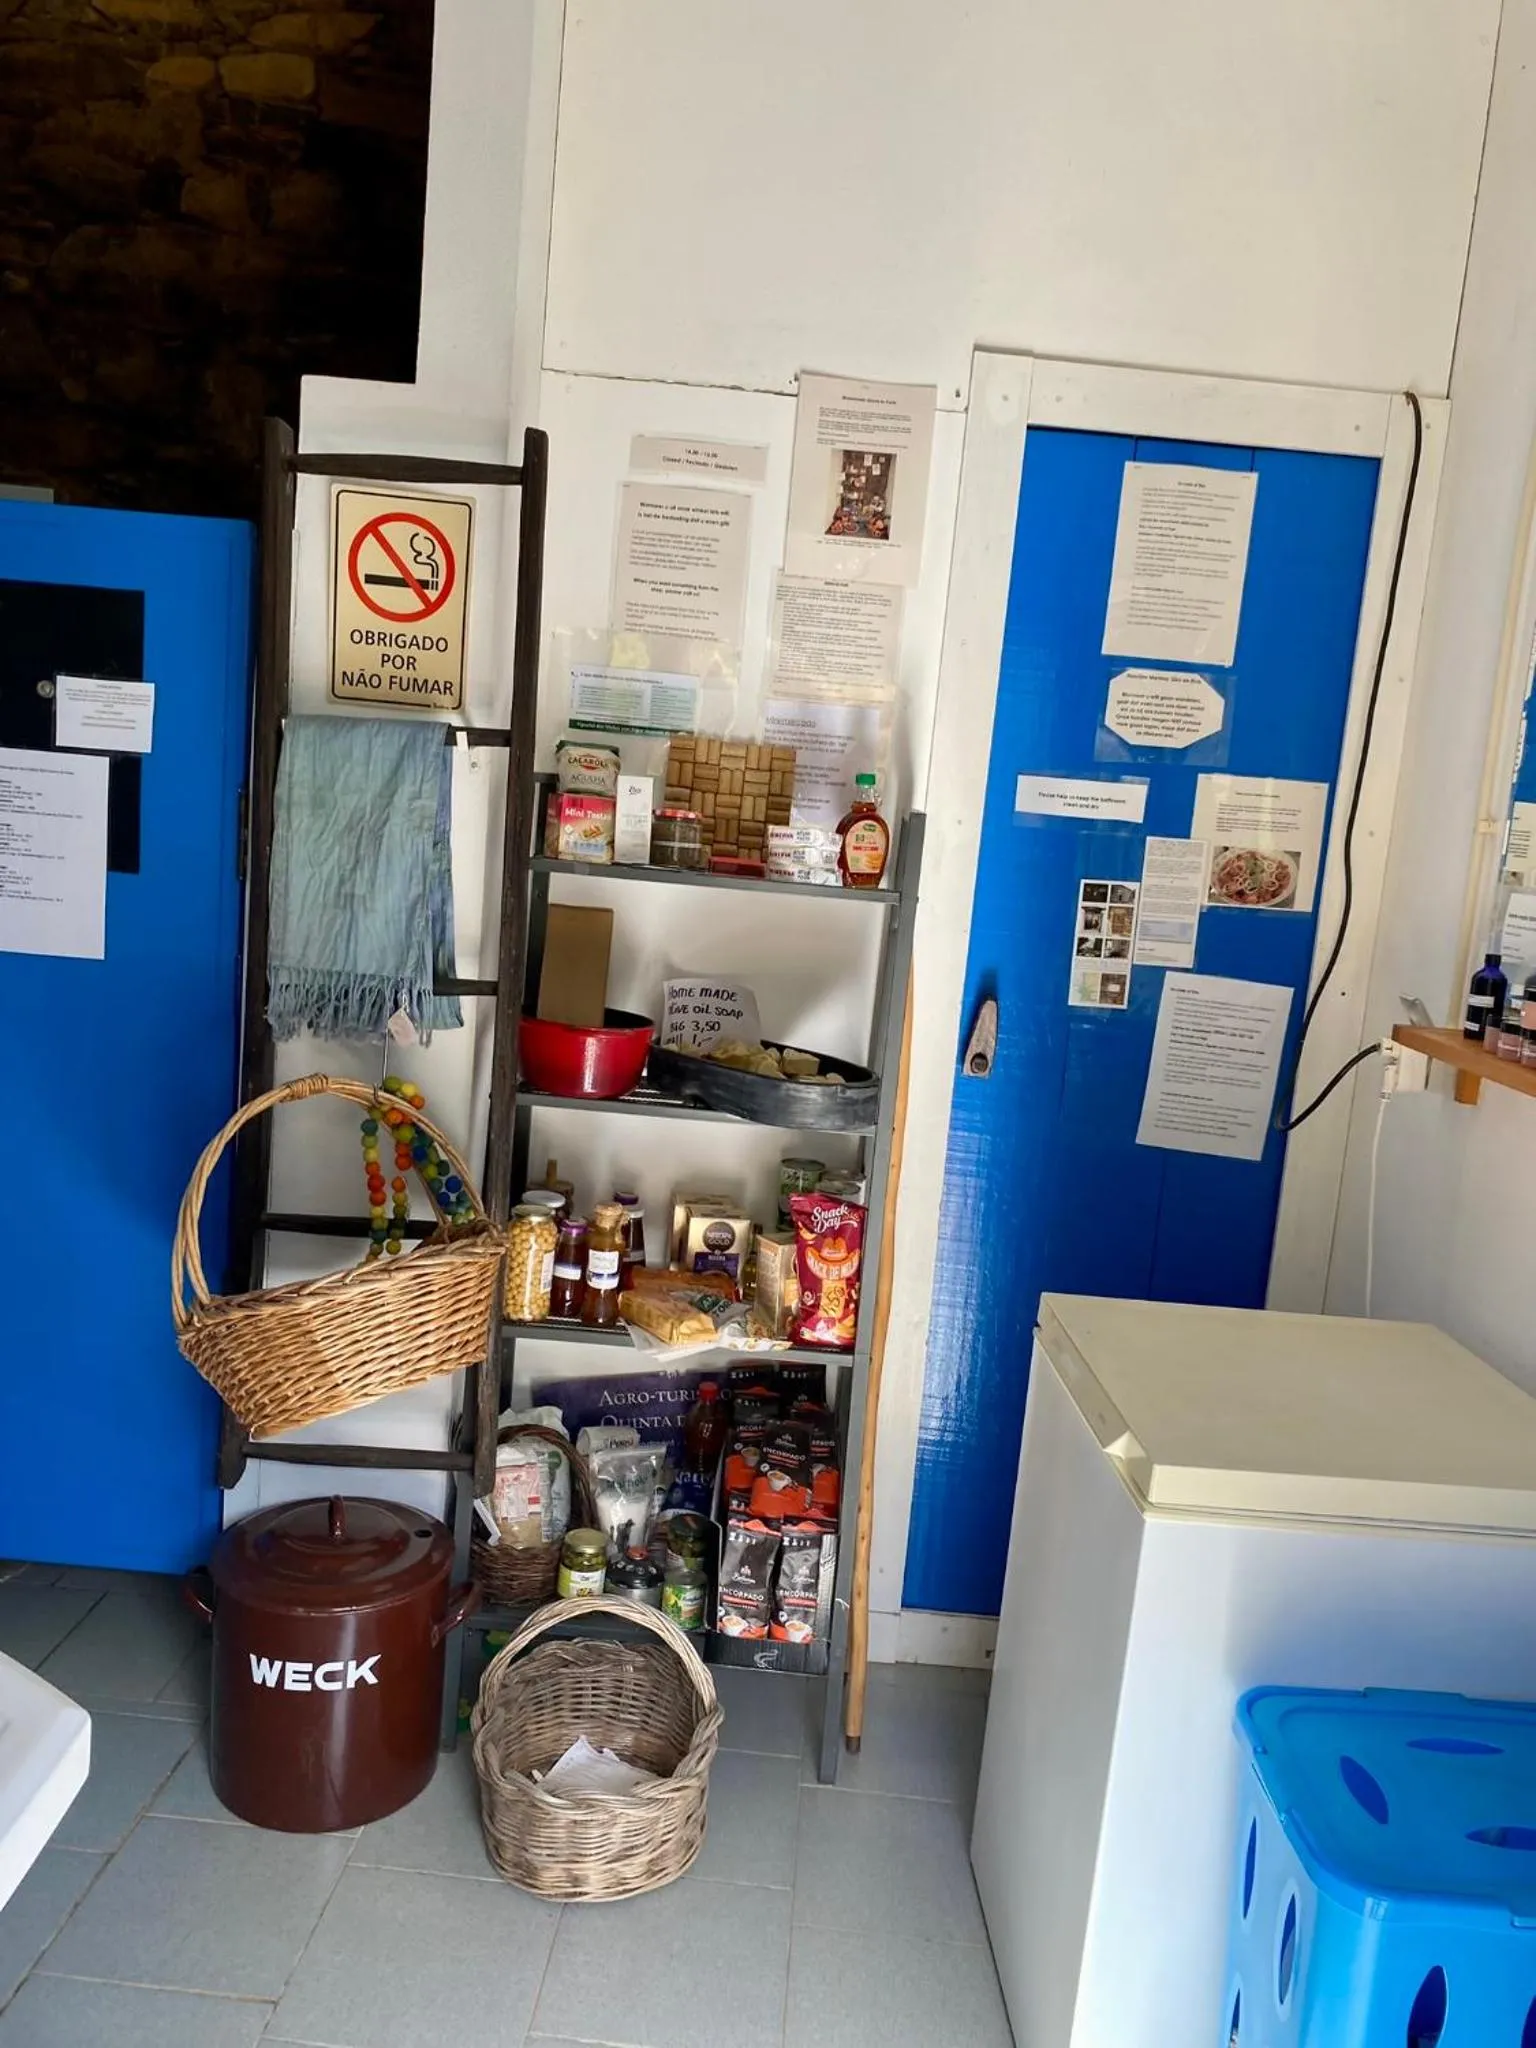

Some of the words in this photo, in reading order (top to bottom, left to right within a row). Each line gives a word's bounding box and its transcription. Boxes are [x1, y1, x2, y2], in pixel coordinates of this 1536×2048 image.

[350, 628, 449, 652] OBRIGADO
[380, 653, 417, 671] POR
[341, 668, 382, 689] NÃO
[388, 675, 454, 697] FUMAR
[699, 987, 740, 1002] MADE
[691, 1020, 721, 1034] 3,50
[811, 1202, 849, 1221] Snack
[813, 1216, 842, 1234] Day
[708, 1238, 731, 1247] GOLD
[598, 1388, 732, 1407] AGRO-TURIO
[600, 1414, 673, 1429] QUINTA
[250, 1653, 382, 1692] WECK
